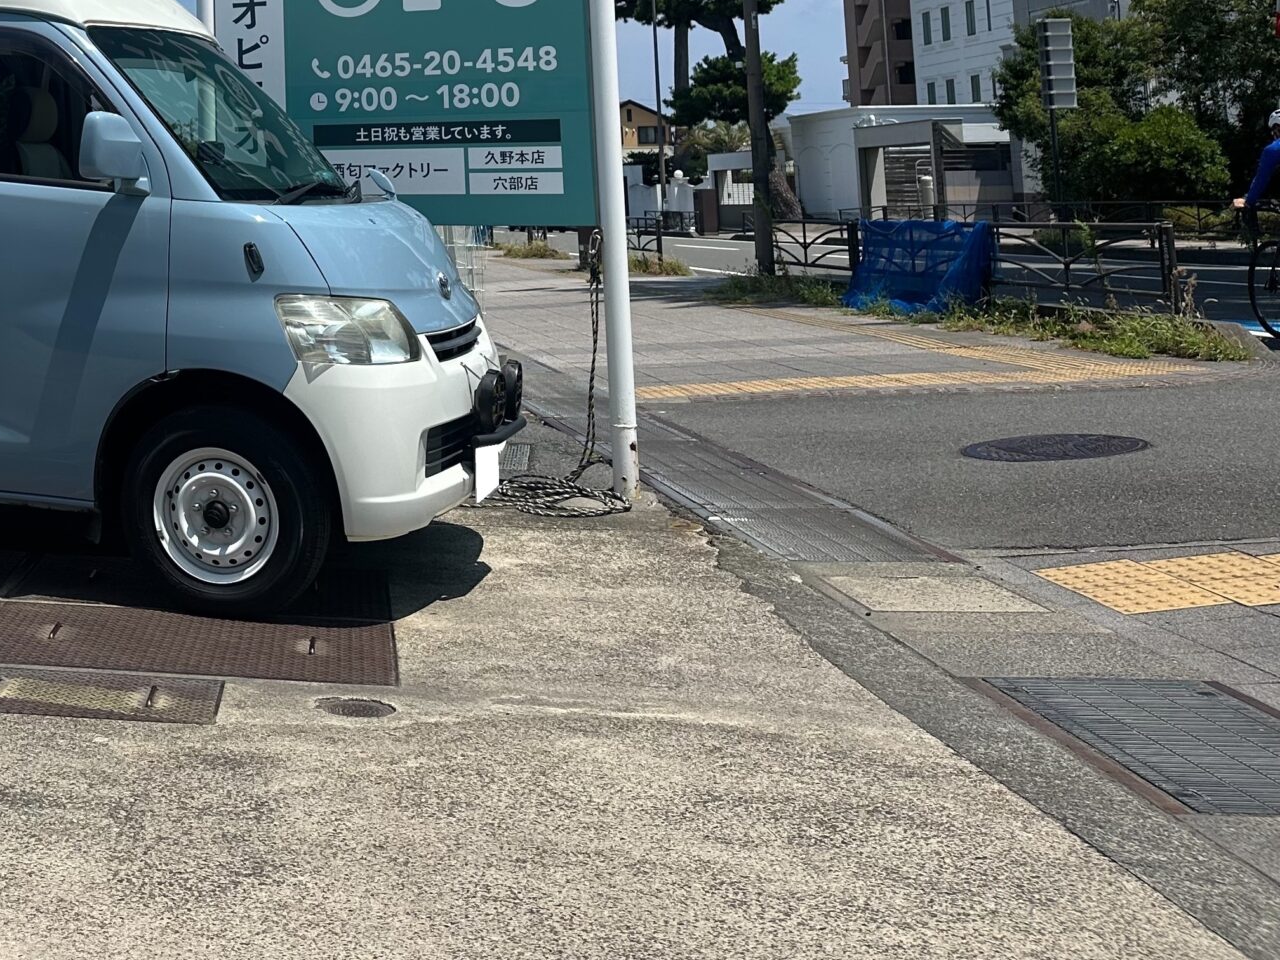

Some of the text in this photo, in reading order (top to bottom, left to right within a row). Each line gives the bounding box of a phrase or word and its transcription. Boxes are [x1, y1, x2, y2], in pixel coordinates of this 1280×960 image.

[337, 45, 558, 79] 0465-20-4548
[356, 124, 512, 142] 土日祝も営業しています。
[484, 149, 545, 165] 久野本店
[493, 175, 538, 191] 穴部店
